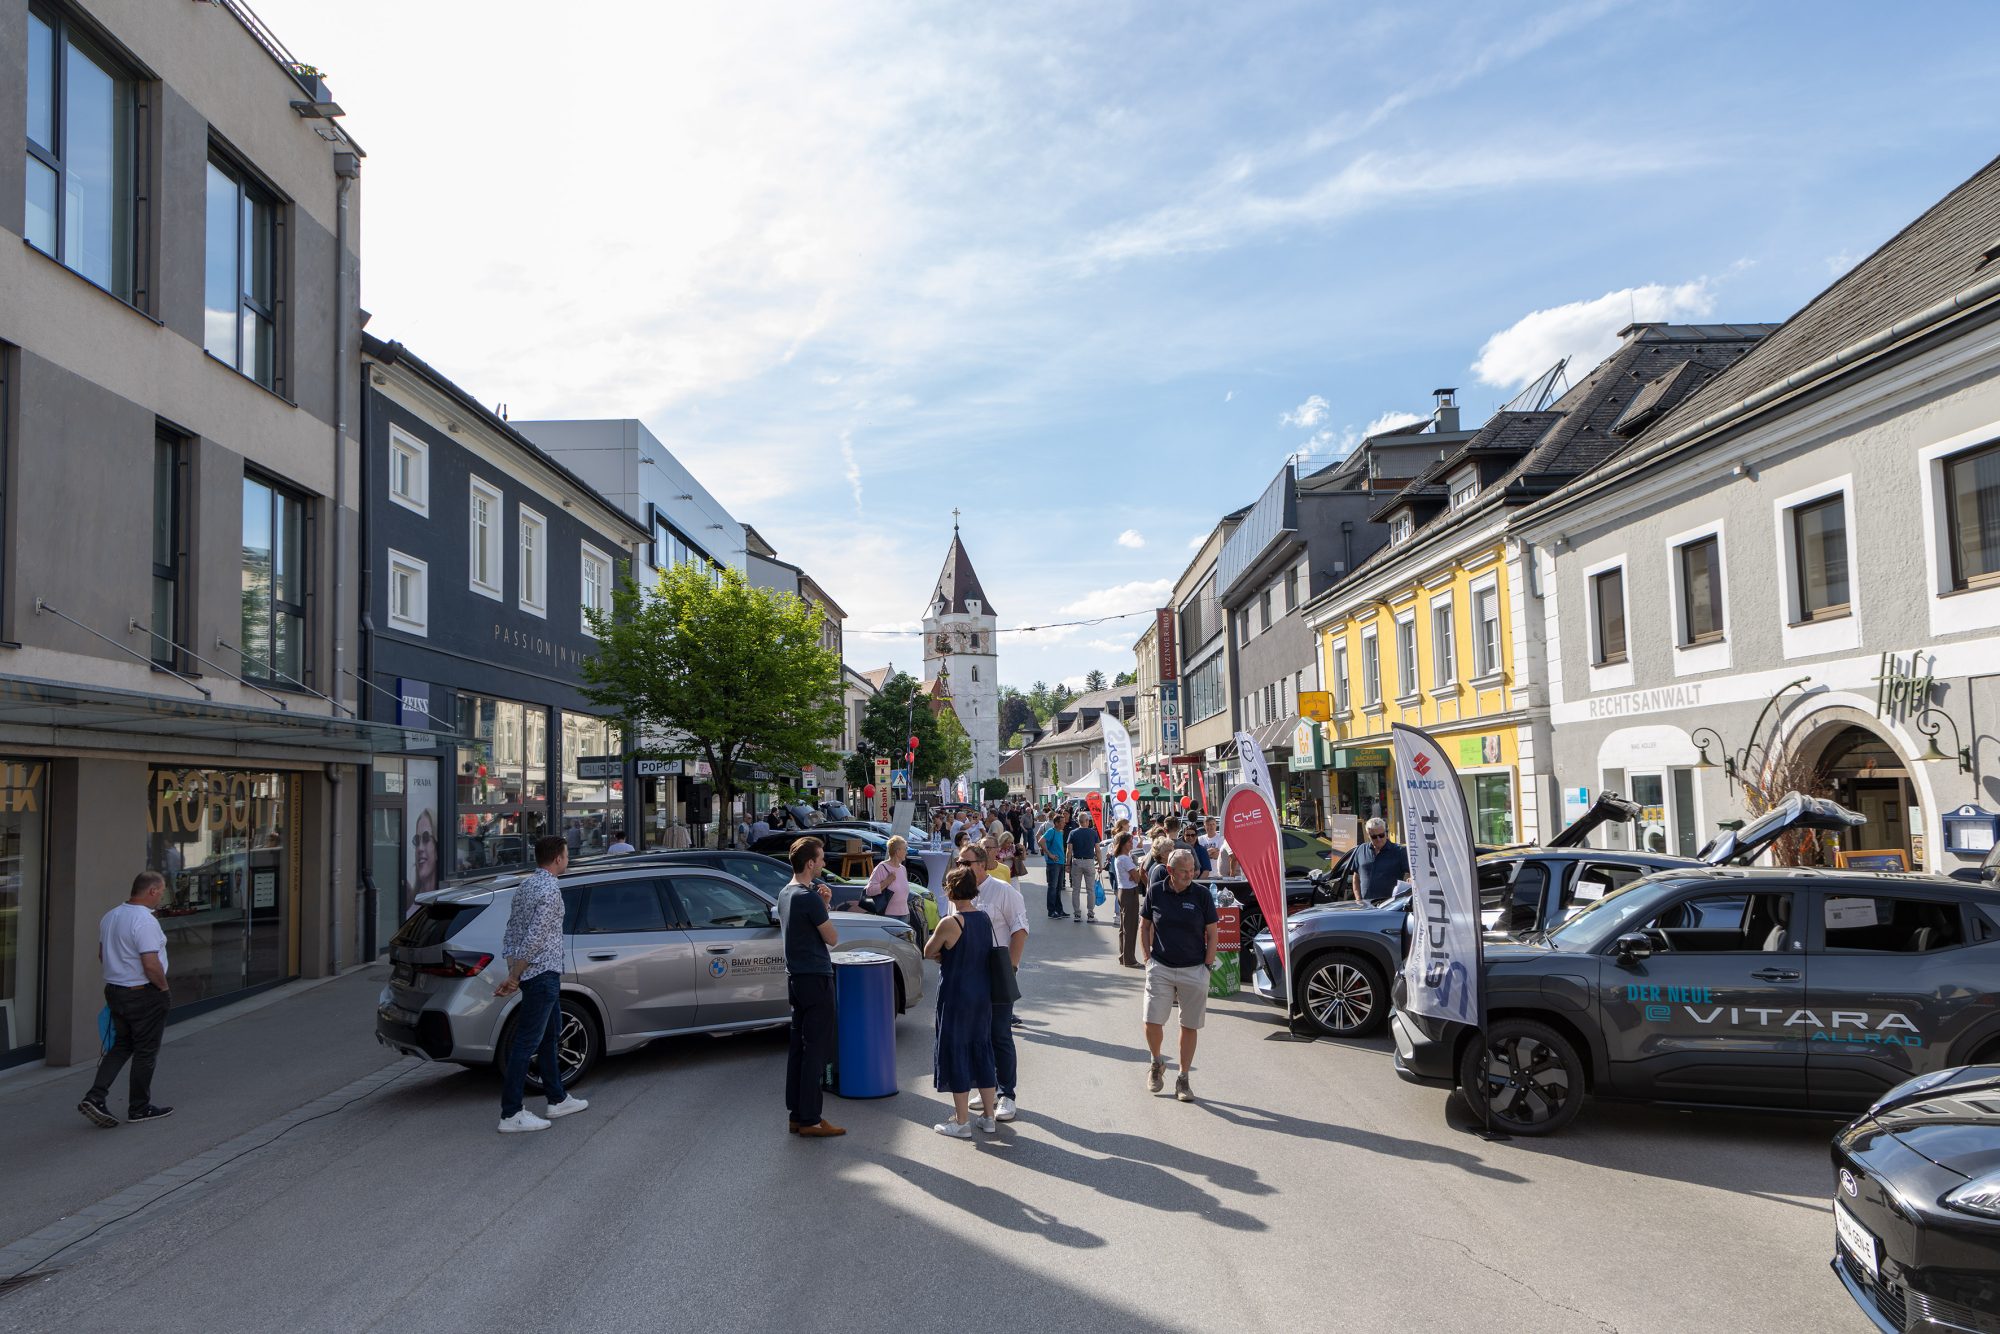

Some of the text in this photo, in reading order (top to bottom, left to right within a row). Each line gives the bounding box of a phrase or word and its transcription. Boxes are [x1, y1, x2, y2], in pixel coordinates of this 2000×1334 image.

[494, 624, 551, 657] PASSION
[1163, 612, 1172, 677] ALTZINGER-HOF
[402, 695, 429, 714] ZEISS
[1589, 684, 1702, 717] RECHTSANWALT
[641, 761, 679, 773] POPUP
[413, 778, 432, 787] PRADA
[732, 958, 751, 966] BMW
[1627, 983, 1713, 1004] DER NEUE
[1683, 1005, 1920, 1033] VITARA
[1811, 1031, 1922, 1047] ALLRAD
